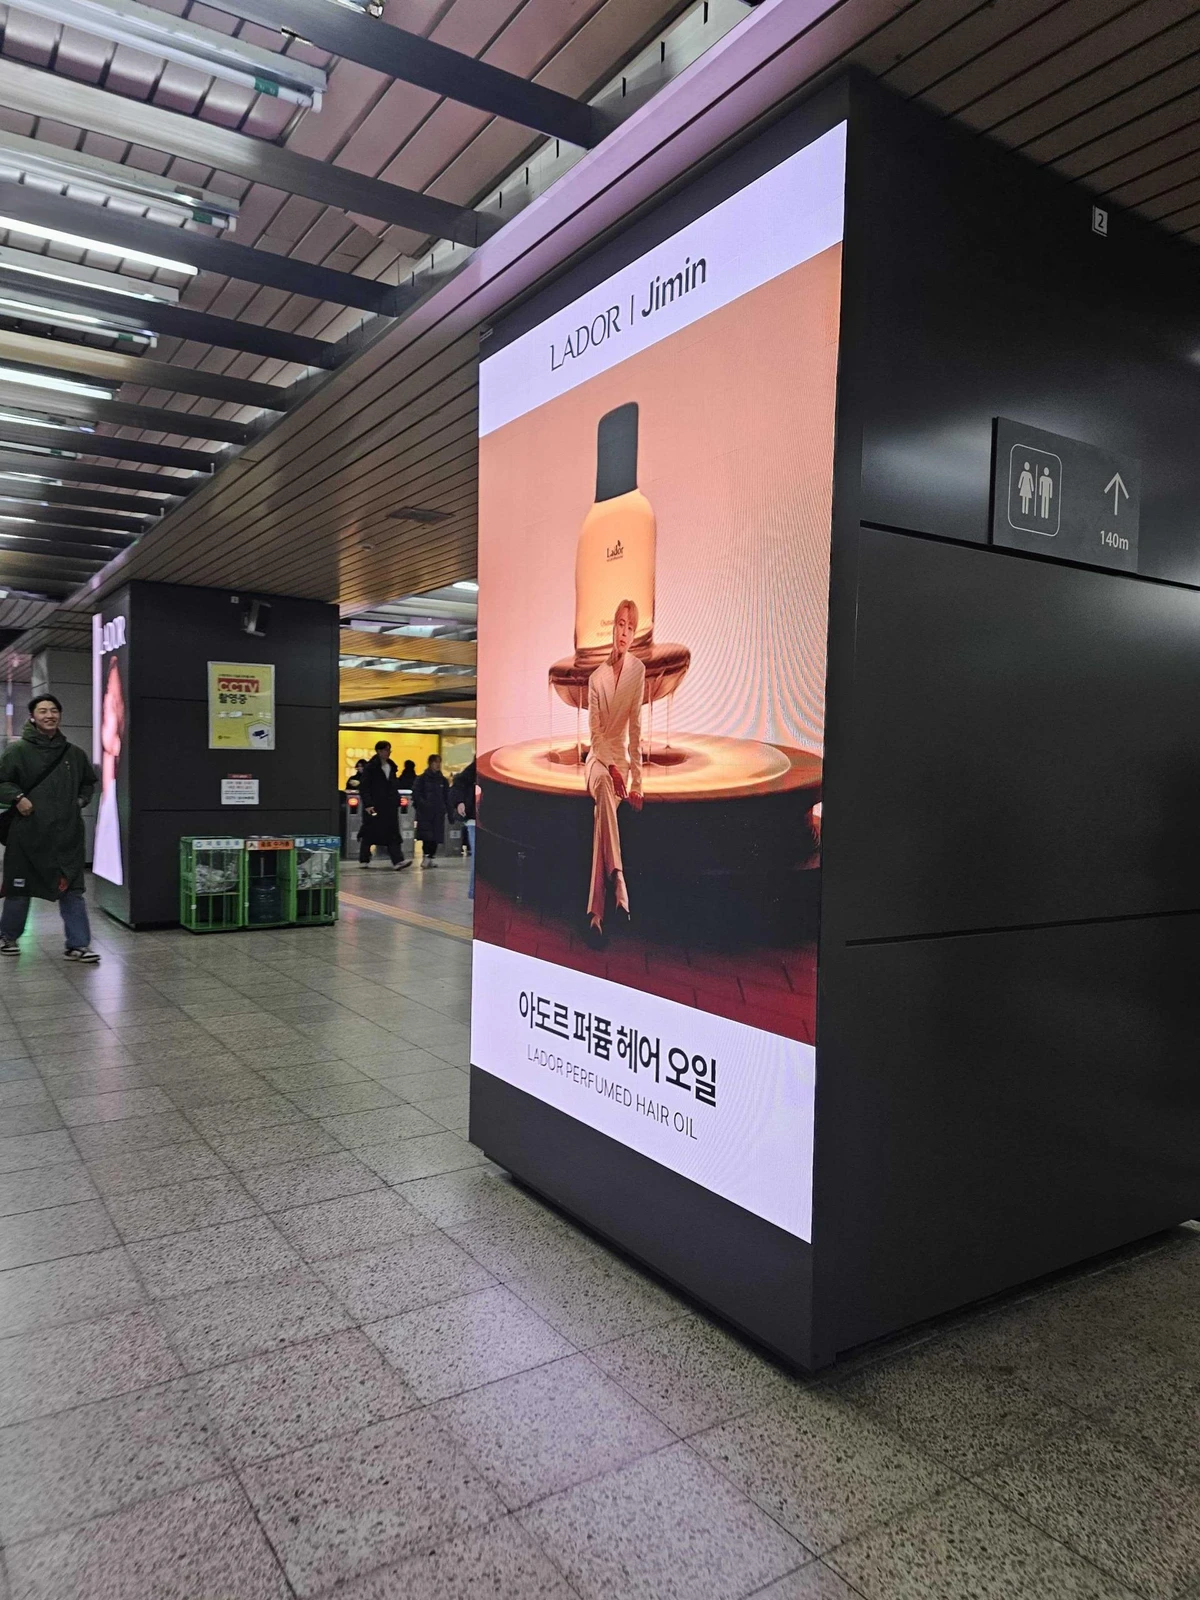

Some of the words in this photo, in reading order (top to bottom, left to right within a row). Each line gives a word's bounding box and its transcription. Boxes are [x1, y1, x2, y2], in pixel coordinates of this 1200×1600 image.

[1098, 213, 1104, 229] 2
[550, 305, 621, 371] LADOR
[641, 257, 706, 318] Jimin
[1100, 530, 1129, 550] 140m
[219, 681, 258, 693] CCTV
[519, 991, 570, 1040] 아도르
[573, 1010, 613, 1061] 퍼퓸
[616, 1025, 661, 1084] 헤어
[665, 1047, 717, 1108] 오일
[527, 1044, 564, 1076] LADOR
[566, 1062, 632, 1107] PERFUMED
[636, 1094, 669, 1126] HAIR
[673, 1111, 698, 1140] OIL
